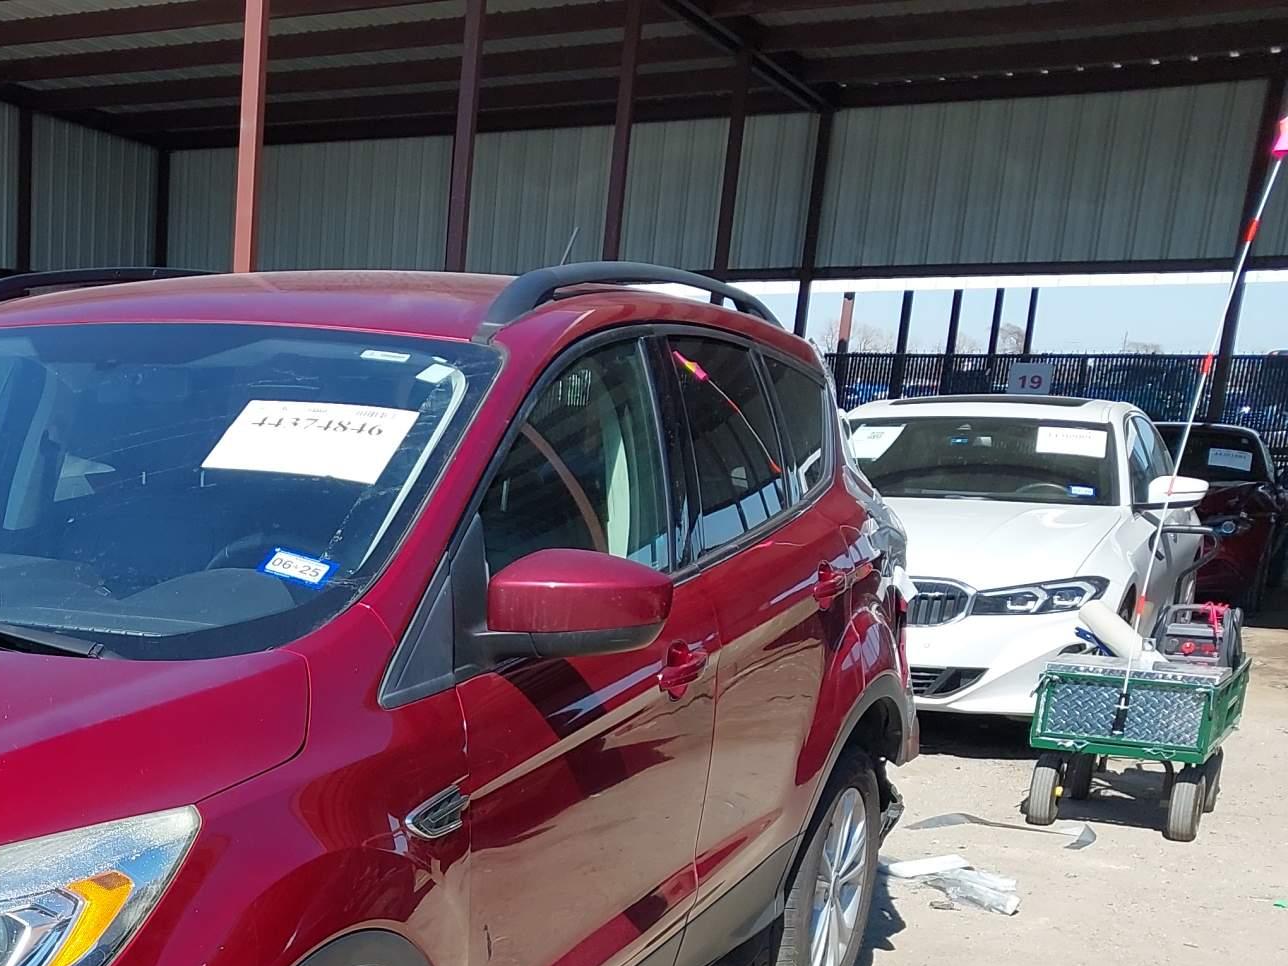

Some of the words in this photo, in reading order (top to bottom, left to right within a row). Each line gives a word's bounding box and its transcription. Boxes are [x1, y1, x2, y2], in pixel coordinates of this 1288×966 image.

[1018, 375, 1043, 390] 19
[271, 557, 294, 570] 06
[298, 565, 322, 578] 25
